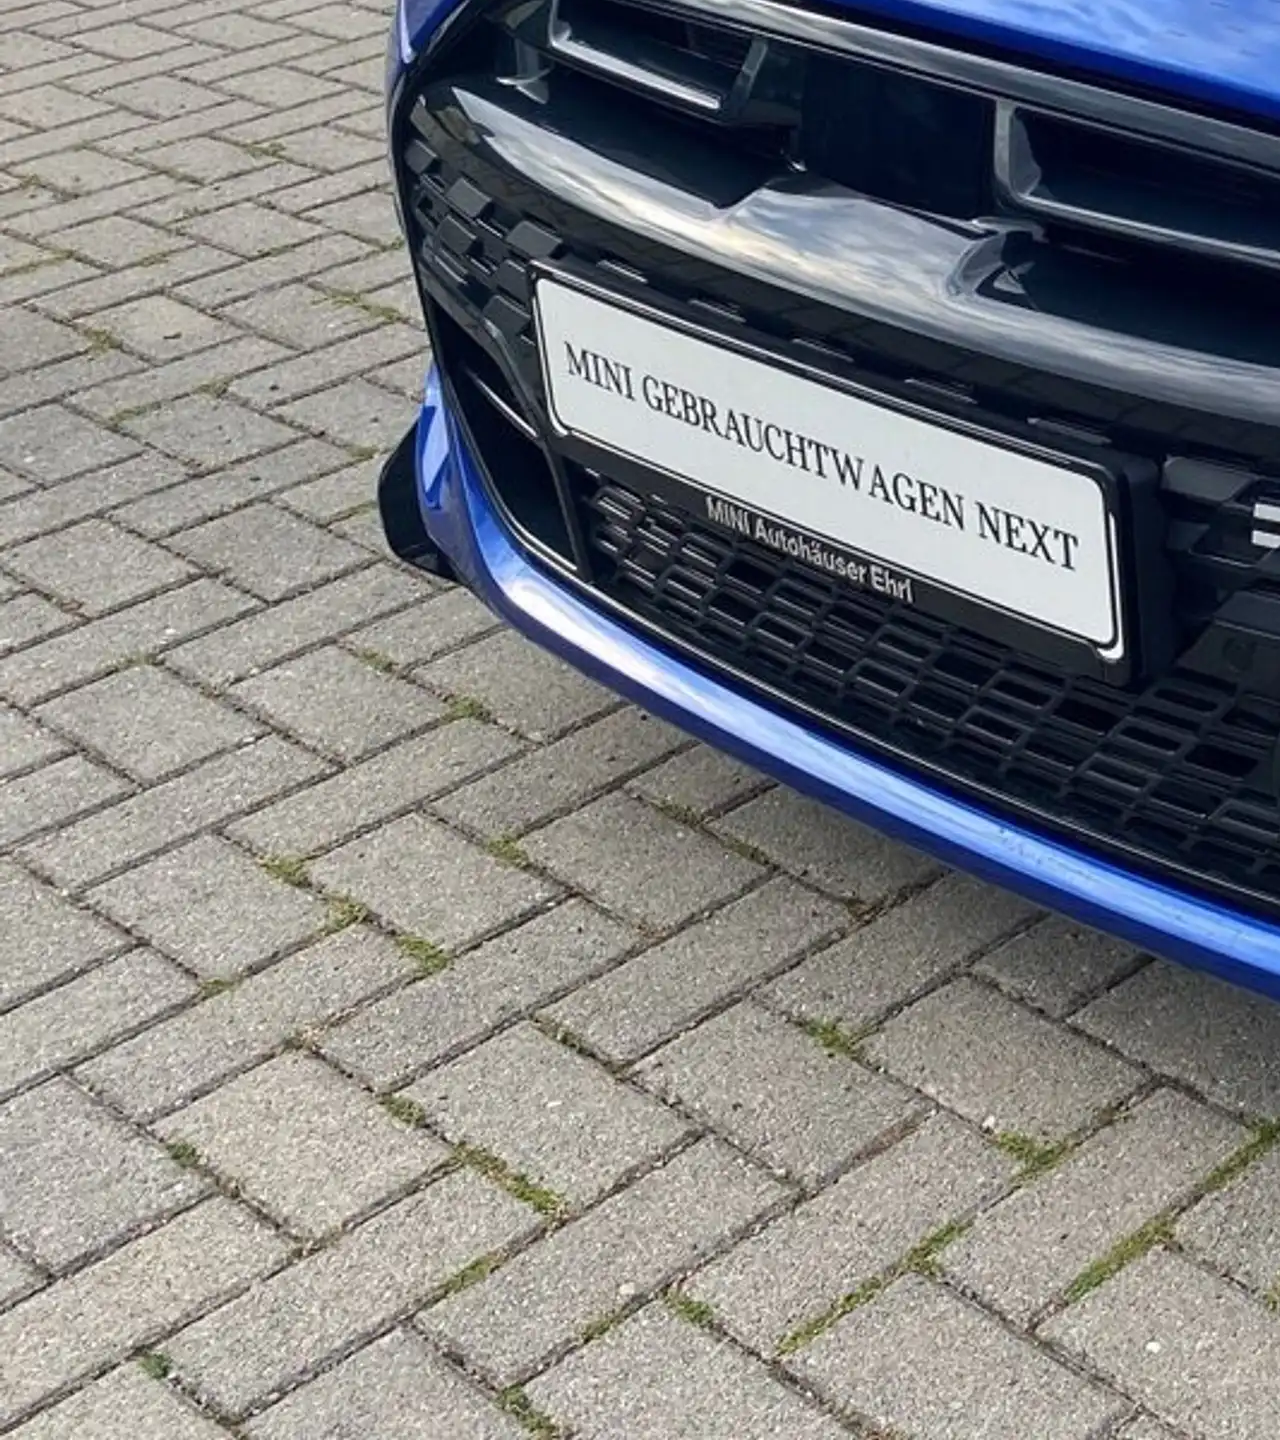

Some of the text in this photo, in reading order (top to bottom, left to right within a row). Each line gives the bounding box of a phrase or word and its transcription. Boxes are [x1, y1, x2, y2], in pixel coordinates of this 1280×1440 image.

[563, 340, 1079, 572] MINI GEBRAUCHTWAGEN NEXT
[705, 495, 914, 604] MINI Autohäuser Ehrl
